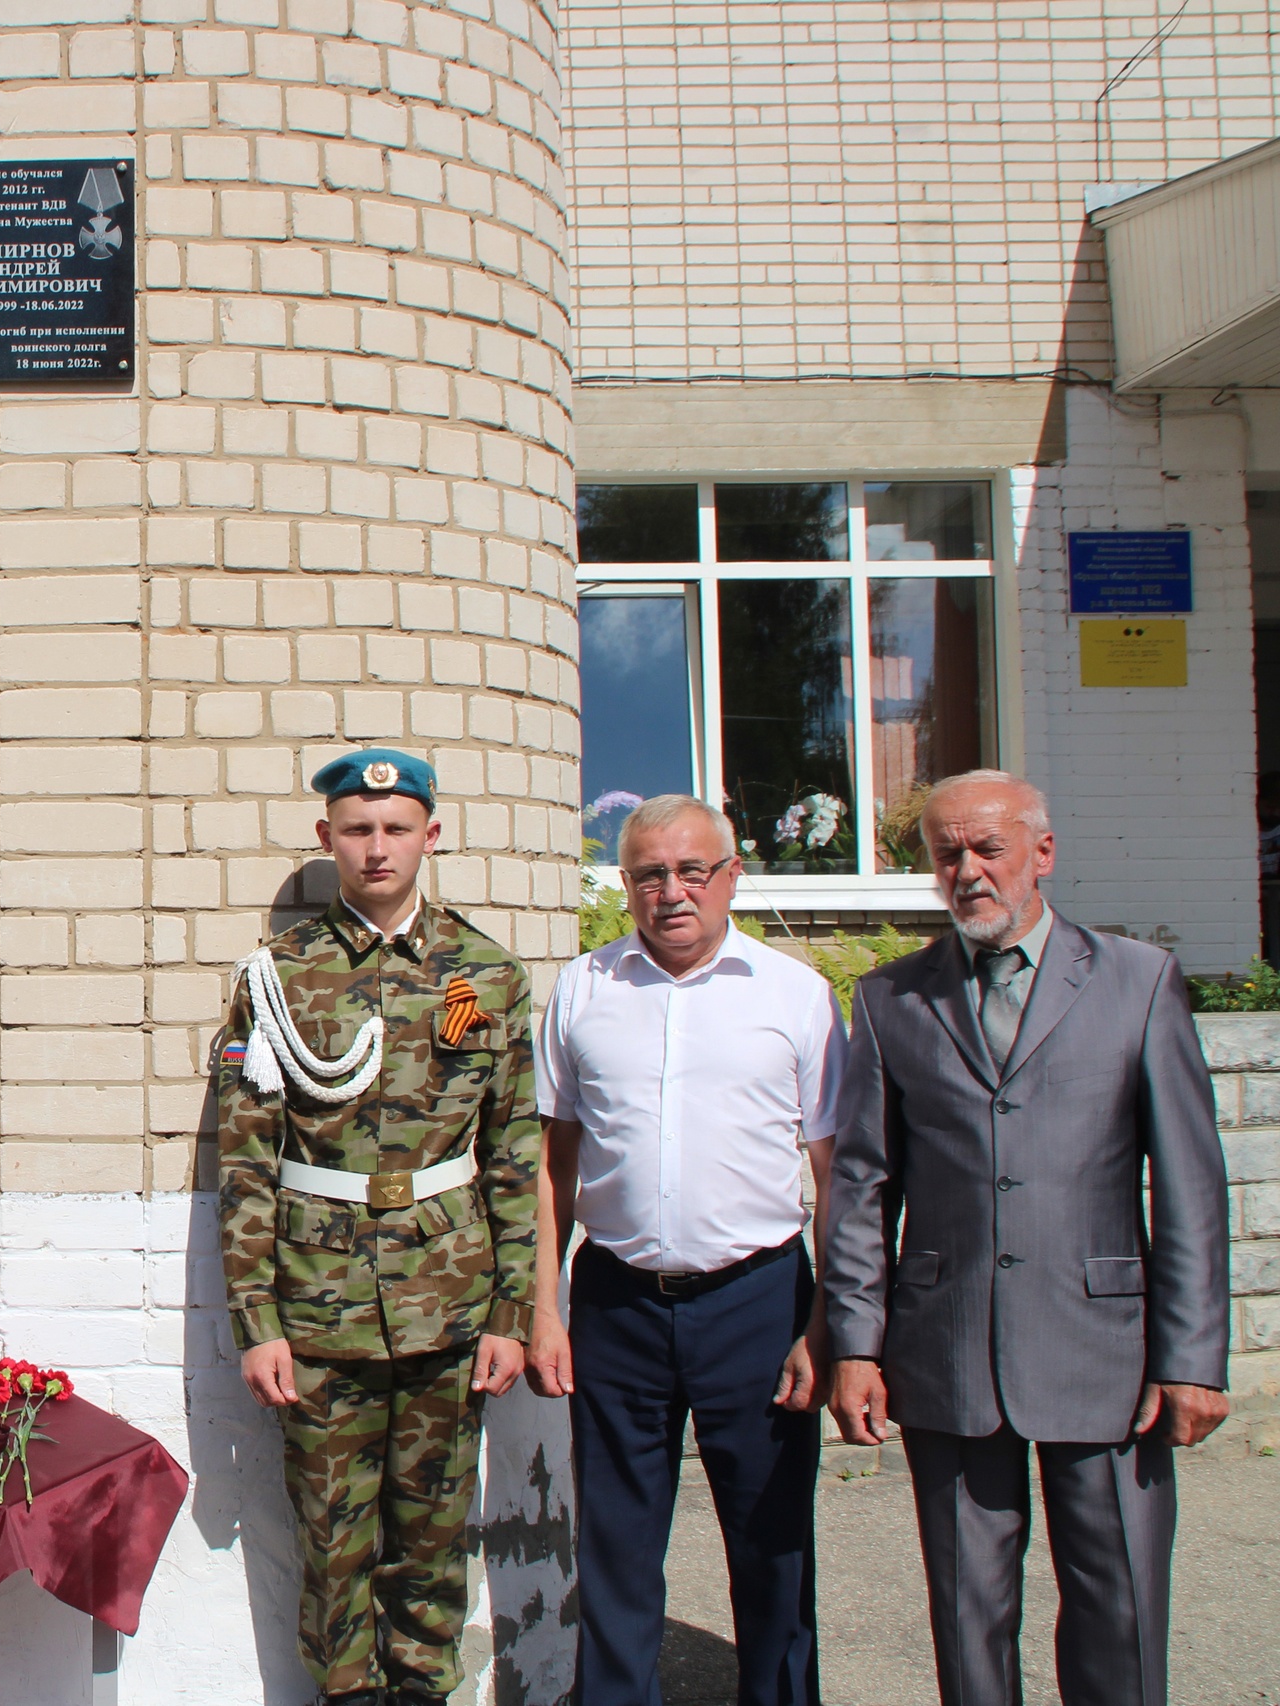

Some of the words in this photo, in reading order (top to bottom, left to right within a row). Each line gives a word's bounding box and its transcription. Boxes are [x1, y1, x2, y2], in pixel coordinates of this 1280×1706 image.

[11, 169, 62, 180] обучался
[3, 185, 28, 194] 2012
[42, 200, 66, 211] ВДВ
[15, 217, 72, 228] Мужества
[30, 328, 51, 338] при
[11, 344, 70, 352] воинского
[74, 344, 106, 352] долга
[17, 359, 28, 368] 18
[68, 358, 101, 368] 2022г.
